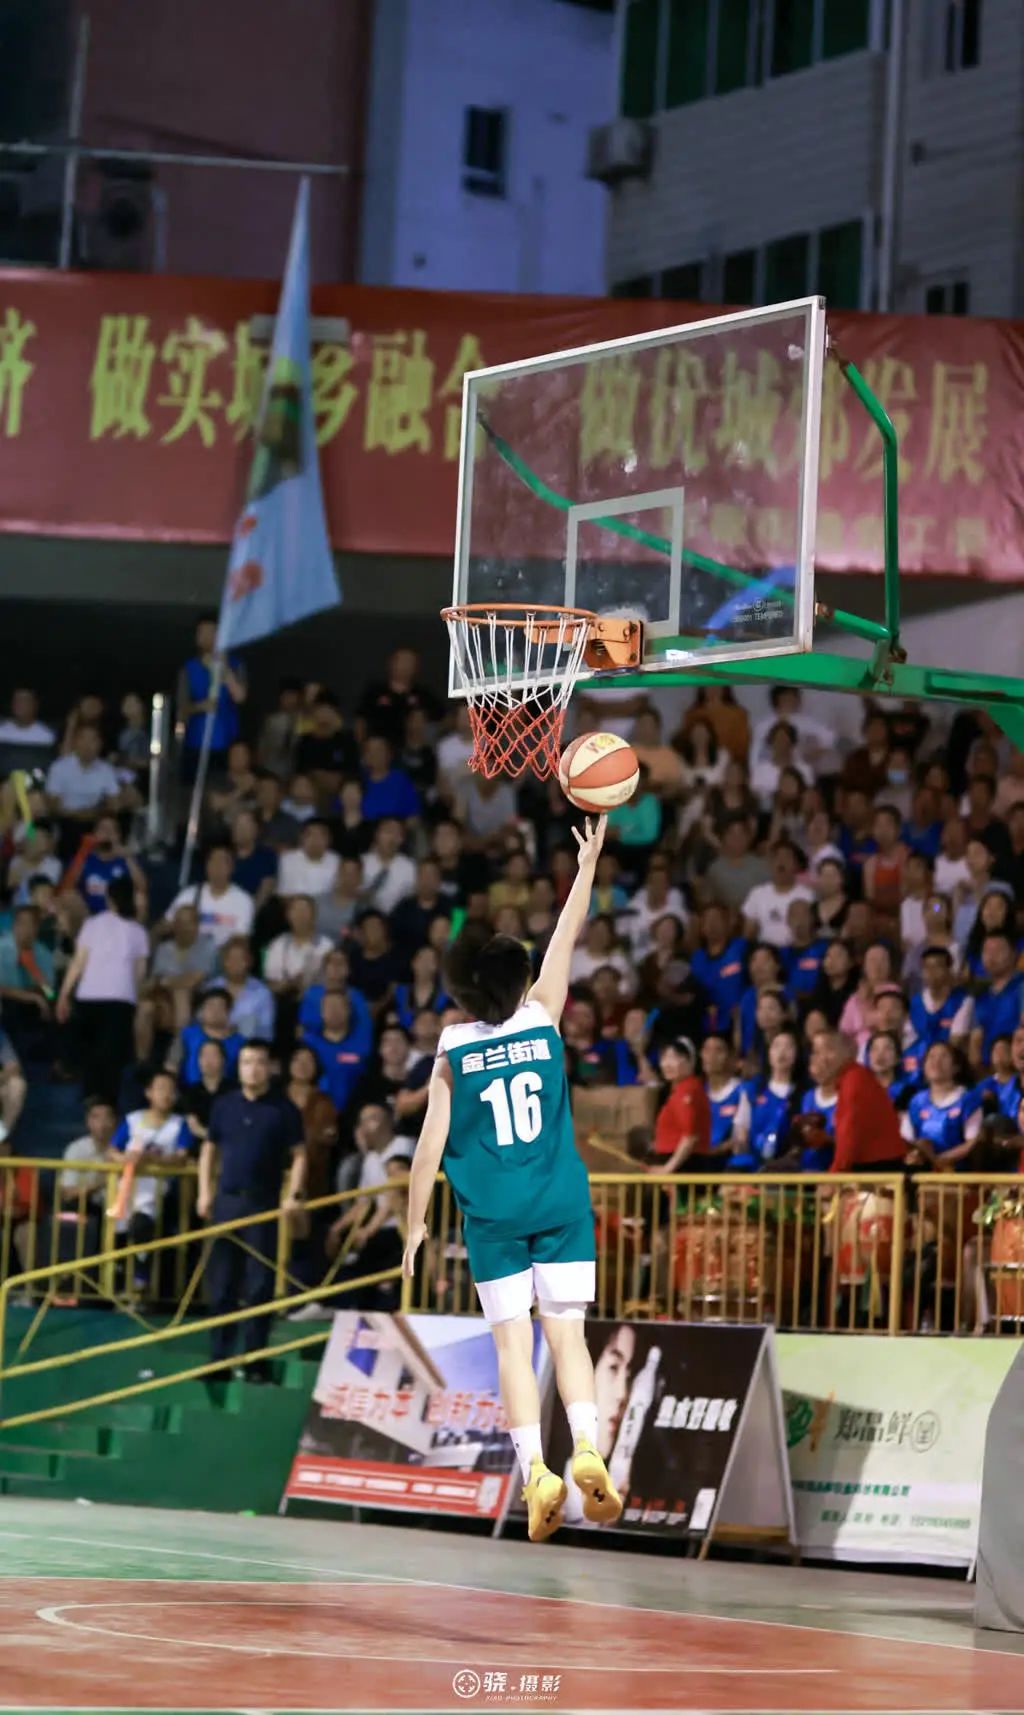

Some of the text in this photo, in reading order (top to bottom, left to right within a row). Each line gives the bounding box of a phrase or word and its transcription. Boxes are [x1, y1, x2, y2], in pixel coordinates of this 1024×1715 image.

[461, 1038, 552, 1074] 金兰街道
[479, 1071, 543, 1146] 16
